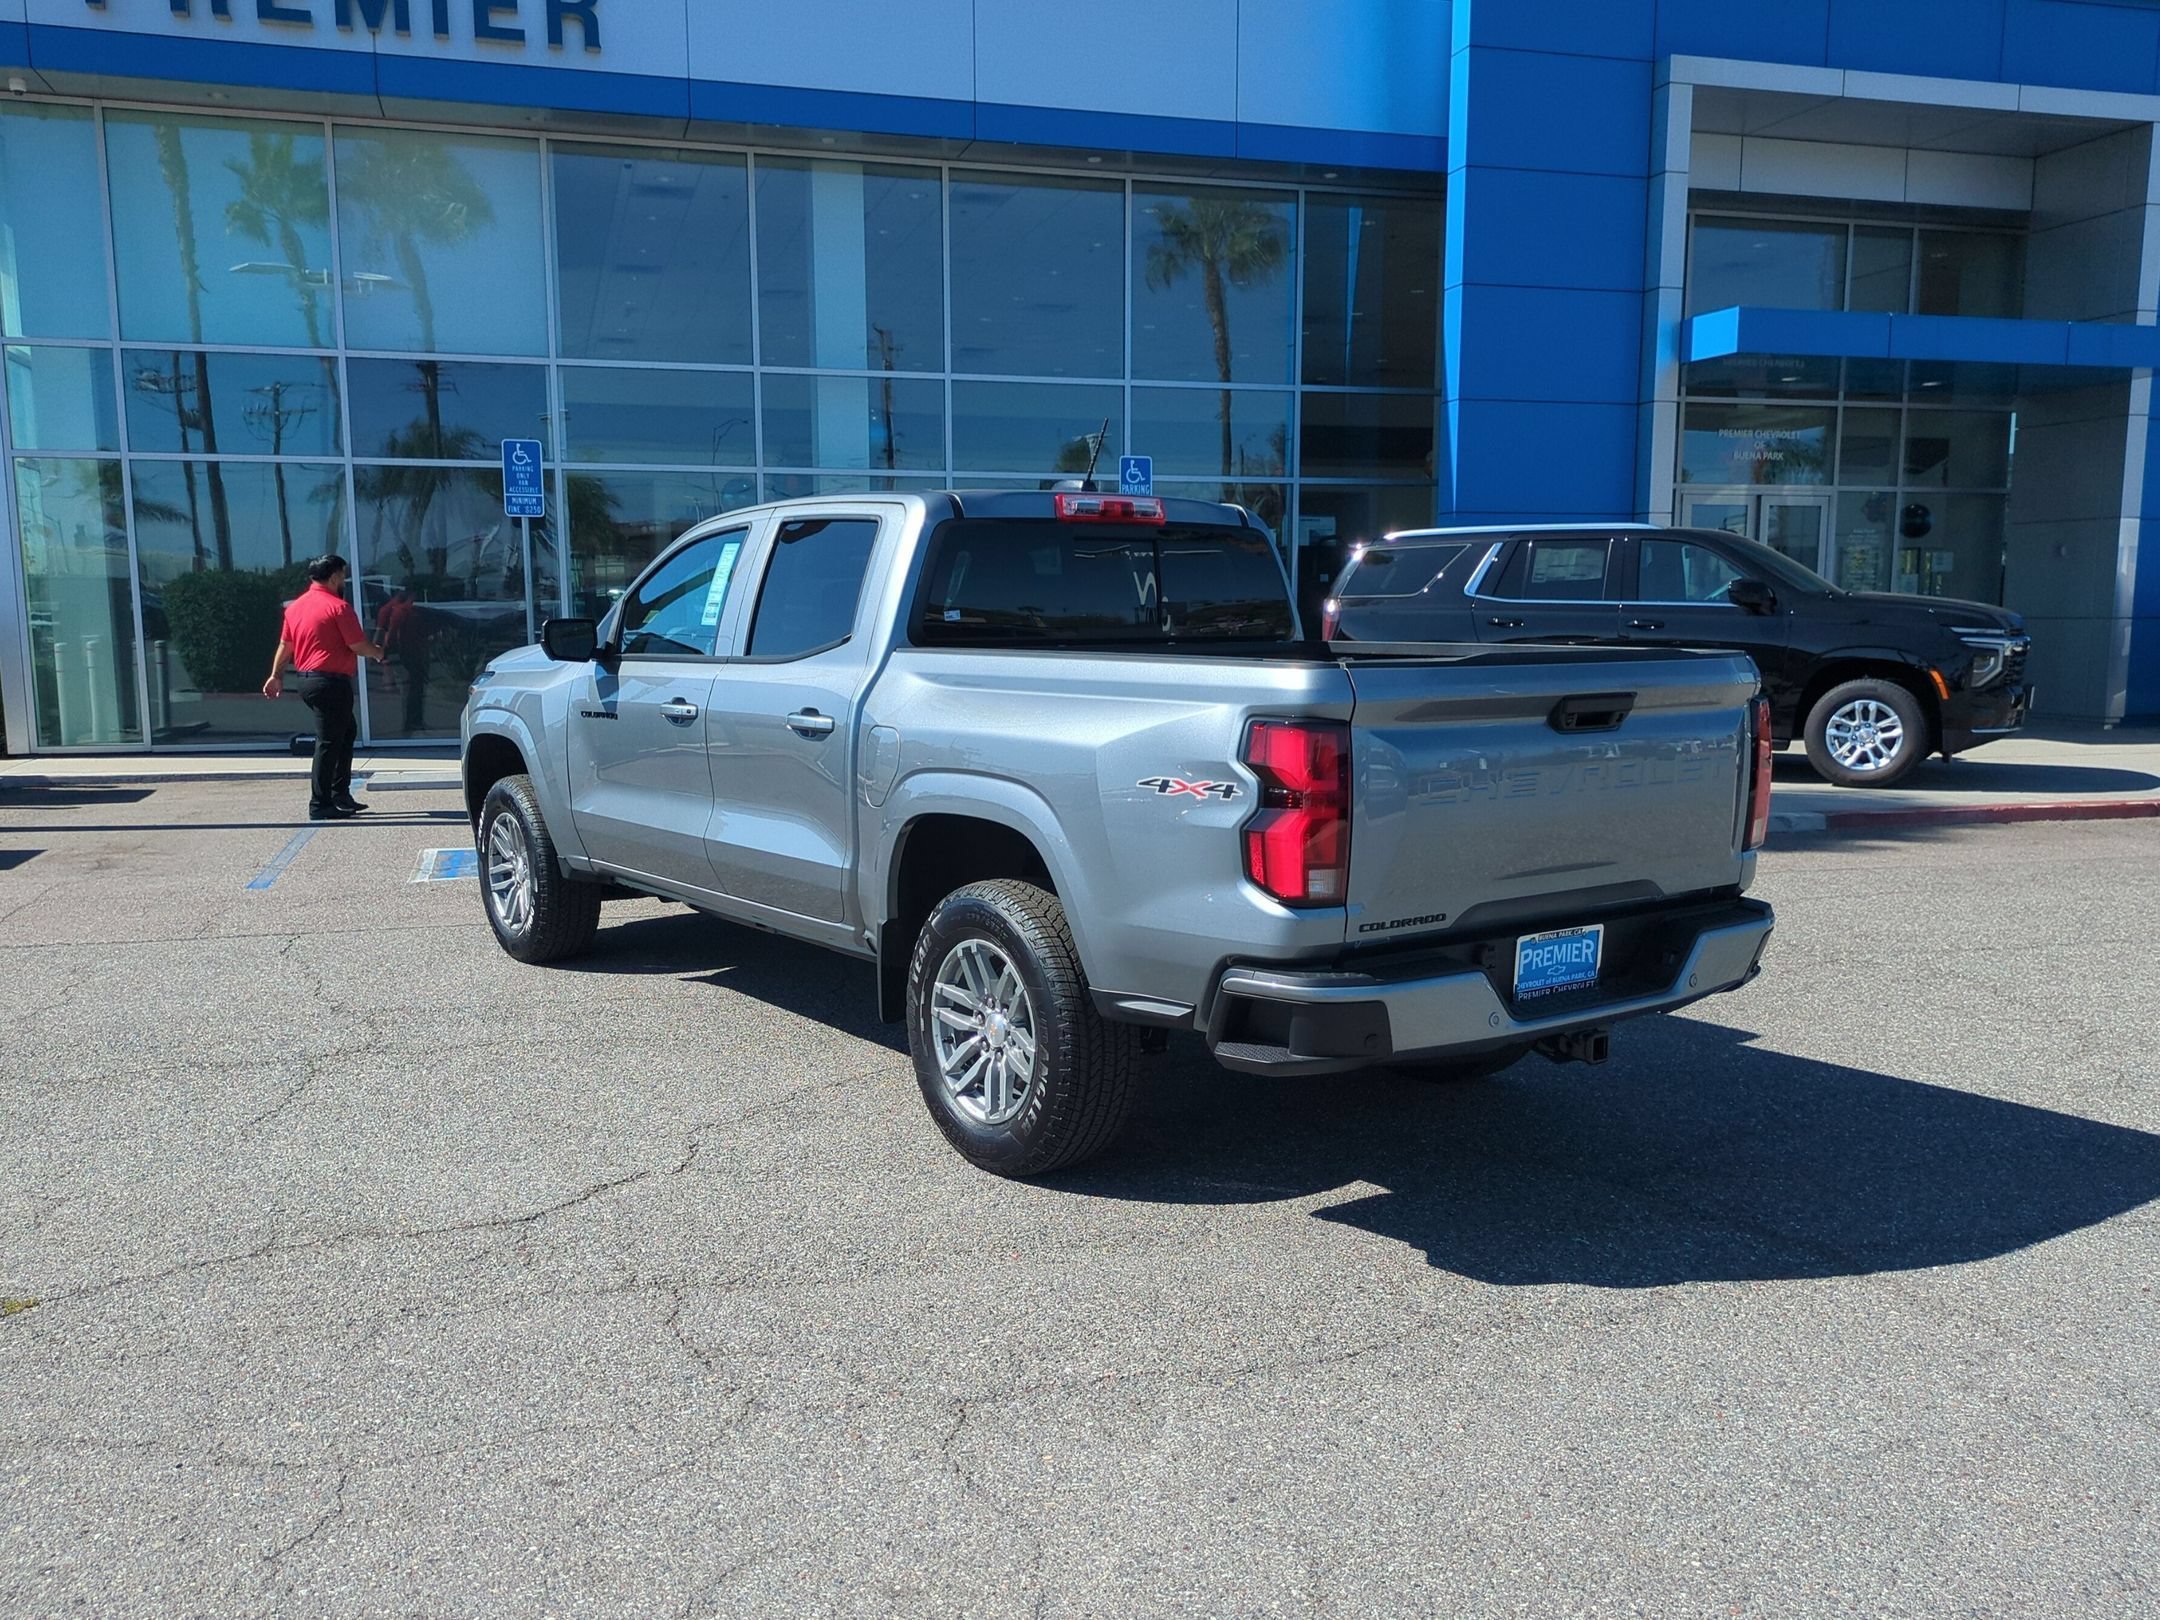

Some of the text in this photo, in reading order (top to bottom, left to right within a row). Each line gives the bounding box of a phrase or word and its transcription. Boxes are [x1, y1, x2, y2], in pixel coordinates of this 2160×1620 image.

[1718, 429, 1801, 440] PREMIER CHEVROLET
[1753, 440, 1766, 450] OF
[1733, 450, 1784, 461] BUENA PARK
[1121, 484, 1150, 495] PARKING
[511, 497, 537, 505] MINIMUM
[508, 505, 521, 513] FINE
[1415, 748, 1734, 806] CHEVROLET
[1359, 913, 1446, 932] COLORADO
[1519, 939, 1595, 975] PREMIER
[1552, 974, 1570, 984] BUENA
[1518, 988, 1550, 1001] PREMIER
